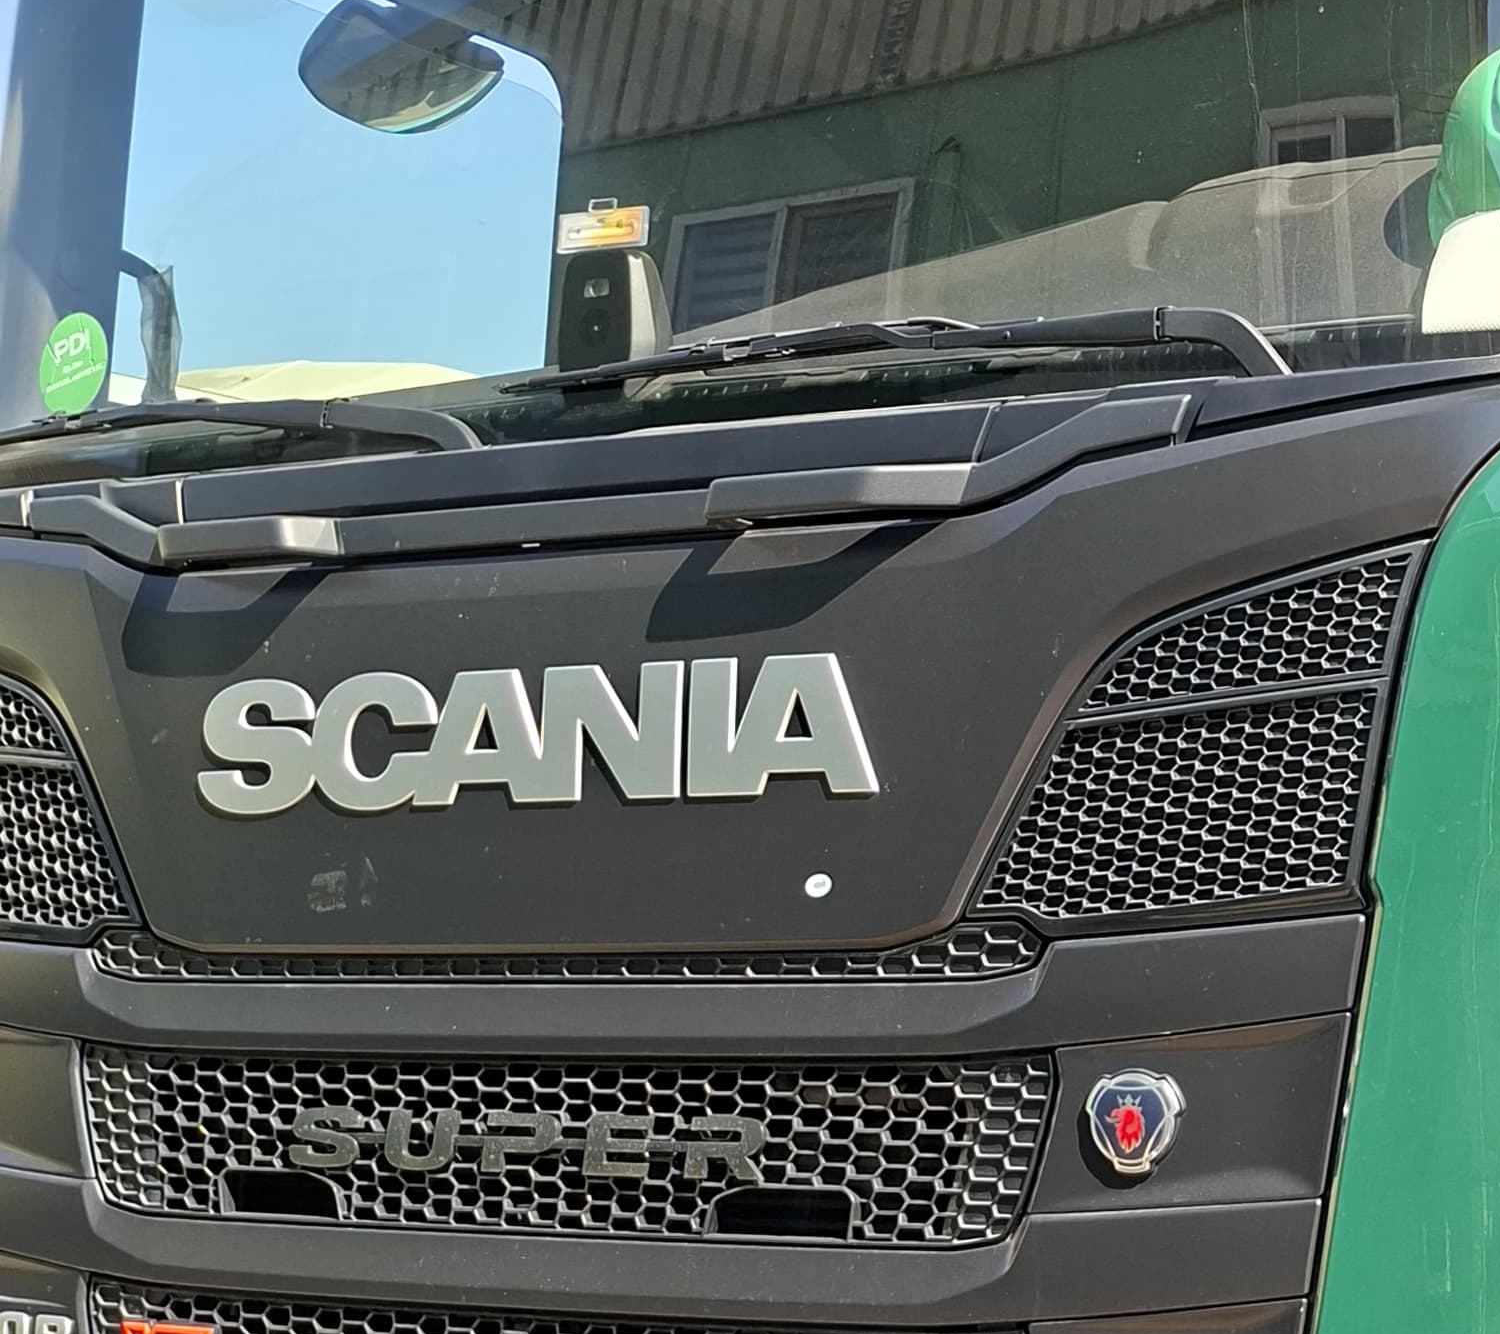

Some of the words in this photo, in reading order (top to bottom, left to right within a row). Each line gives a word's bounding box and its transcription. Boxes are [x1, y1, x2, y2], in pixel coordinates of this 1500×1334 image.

[54, 327, 91, 364] PDI
[197, 653, 880, 817] SCANIA
[289, 1105, 767, 1181] SUPER
